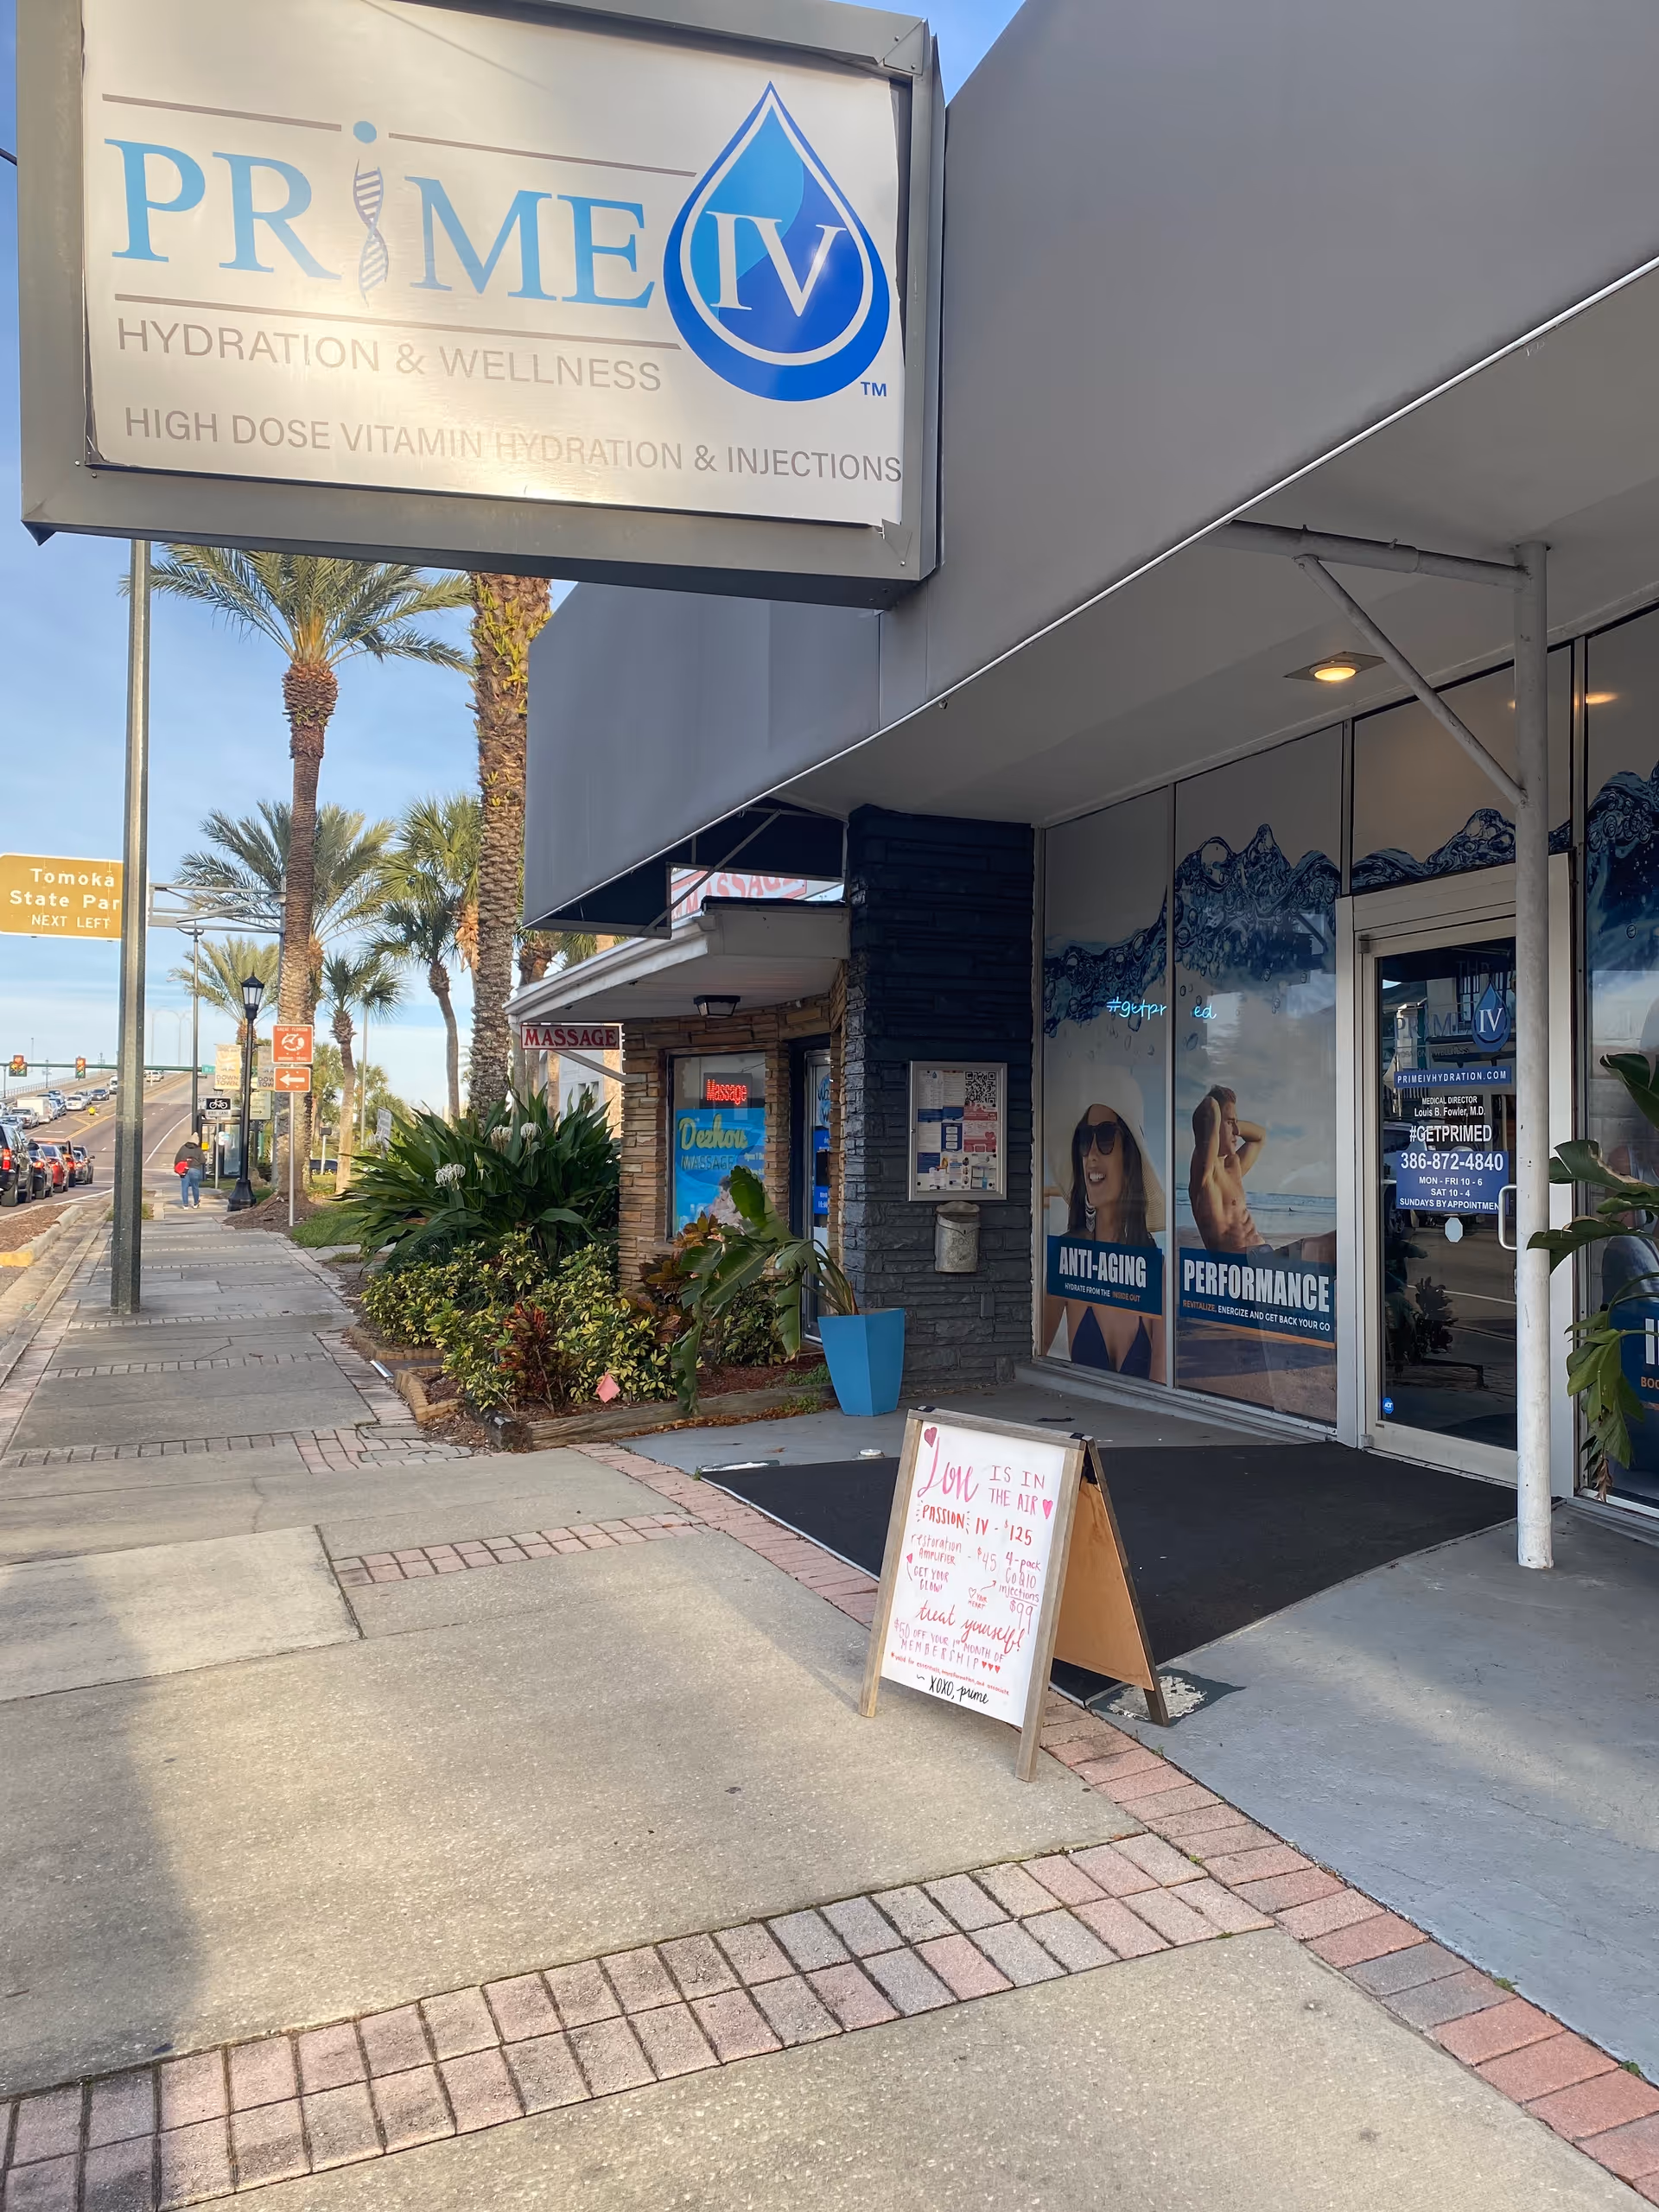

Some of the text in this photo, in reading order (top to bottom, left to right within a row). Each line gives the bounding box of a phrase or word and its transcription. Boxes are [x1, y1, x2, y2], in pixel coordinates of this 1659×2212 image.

[706, 210, 847, 317] IV
[118, 318, 662, 391] HYDRATION & WELLNESS
[125, 407, 902, 482] HIGH DOSE VITAMIN HYDRATION & INJECTIONS
[29, 868, 115, 887] Tomoka
[10, 890, 121, 911] State Par
[31, 913, 111, 929] NEXT LEFT
[1479, 1007, 1503, 1033] IV
[524, 1028, 617, 1046] MASSAGE
[1397, 1071, 1507, 1084] PRIMEIVHYDRATION.COM
[706, 1079, 747, 1105] Massage
[1414, 1108, 1433, 1116] Louis
[1471, 1106, 1485, 1116] M.D.
[678, 1114, 748, 1151] Dezhou
[1409, 1125, 1492, 1142] #GETPRIMED
[681, 1155, 734, 1170] MASSAGE
[1401, 1153, 1503, 1171] 386-872-4840
[1400, 1198, 1434, 1207] SUNDAYS
[1447, 1201, 1500, 1211] APPOINTMEN
[1058, 1247, 1147, 1288] ANTI-AGING
[1065, 1282, 1085, 1293] HYDRATE
[1086, 1287, 1100, 1295] FROM
[1101, 1288, 1110, 1297] THE
[1184, 1259, 1330, 1313] PERFORMANCE
[1217, 1305, 1249, 1318] ENERGIZE
[1249, 1311, 1264, 1320] AND
[1265, 1313, 1278, 1323] GET
[1279, 1315, 1298, 1326] BACK
[1299, 1319, 1318, 1330] YOUR
[1319, 1322, 1331, 1332] GO
[1645, 1318, 1659, 1366] I
[917, 1437, 1045, 1503] Love IS IN
[988, 1488, 1038, 1516] THE AIR
[922, 1504, 965, 1529] PASSION
[976, 1517, 988, 1535] IV
[1004, 1519, 1033, 1546] $125
[911, 1534, 962, 1554] restoration
[918, 1548, 956, 1566] AMPLIFIER
[977, 1547, 997, 1572] $45
[1005, 1552, 1041, 1573] 4-pack
[914, 1566, 949, 1582] GET YOUR
[999, 1585, 1039, 1603] injections
[915, 1600, 1026, 1654] treat yourself!
[1009, 1600, 1033, 1635] $99
[900, 1639, 980, 1669] MEMBERSHIP
[912, 1630, 927, 1639] OFF
[931, 1632, 949, 1645] YOUR
[963, 1643, 991, 1660] MONTH
[995, 1654, 1006, 1664] OF
[929, 1675, 989, 1705] XOXO, prime
